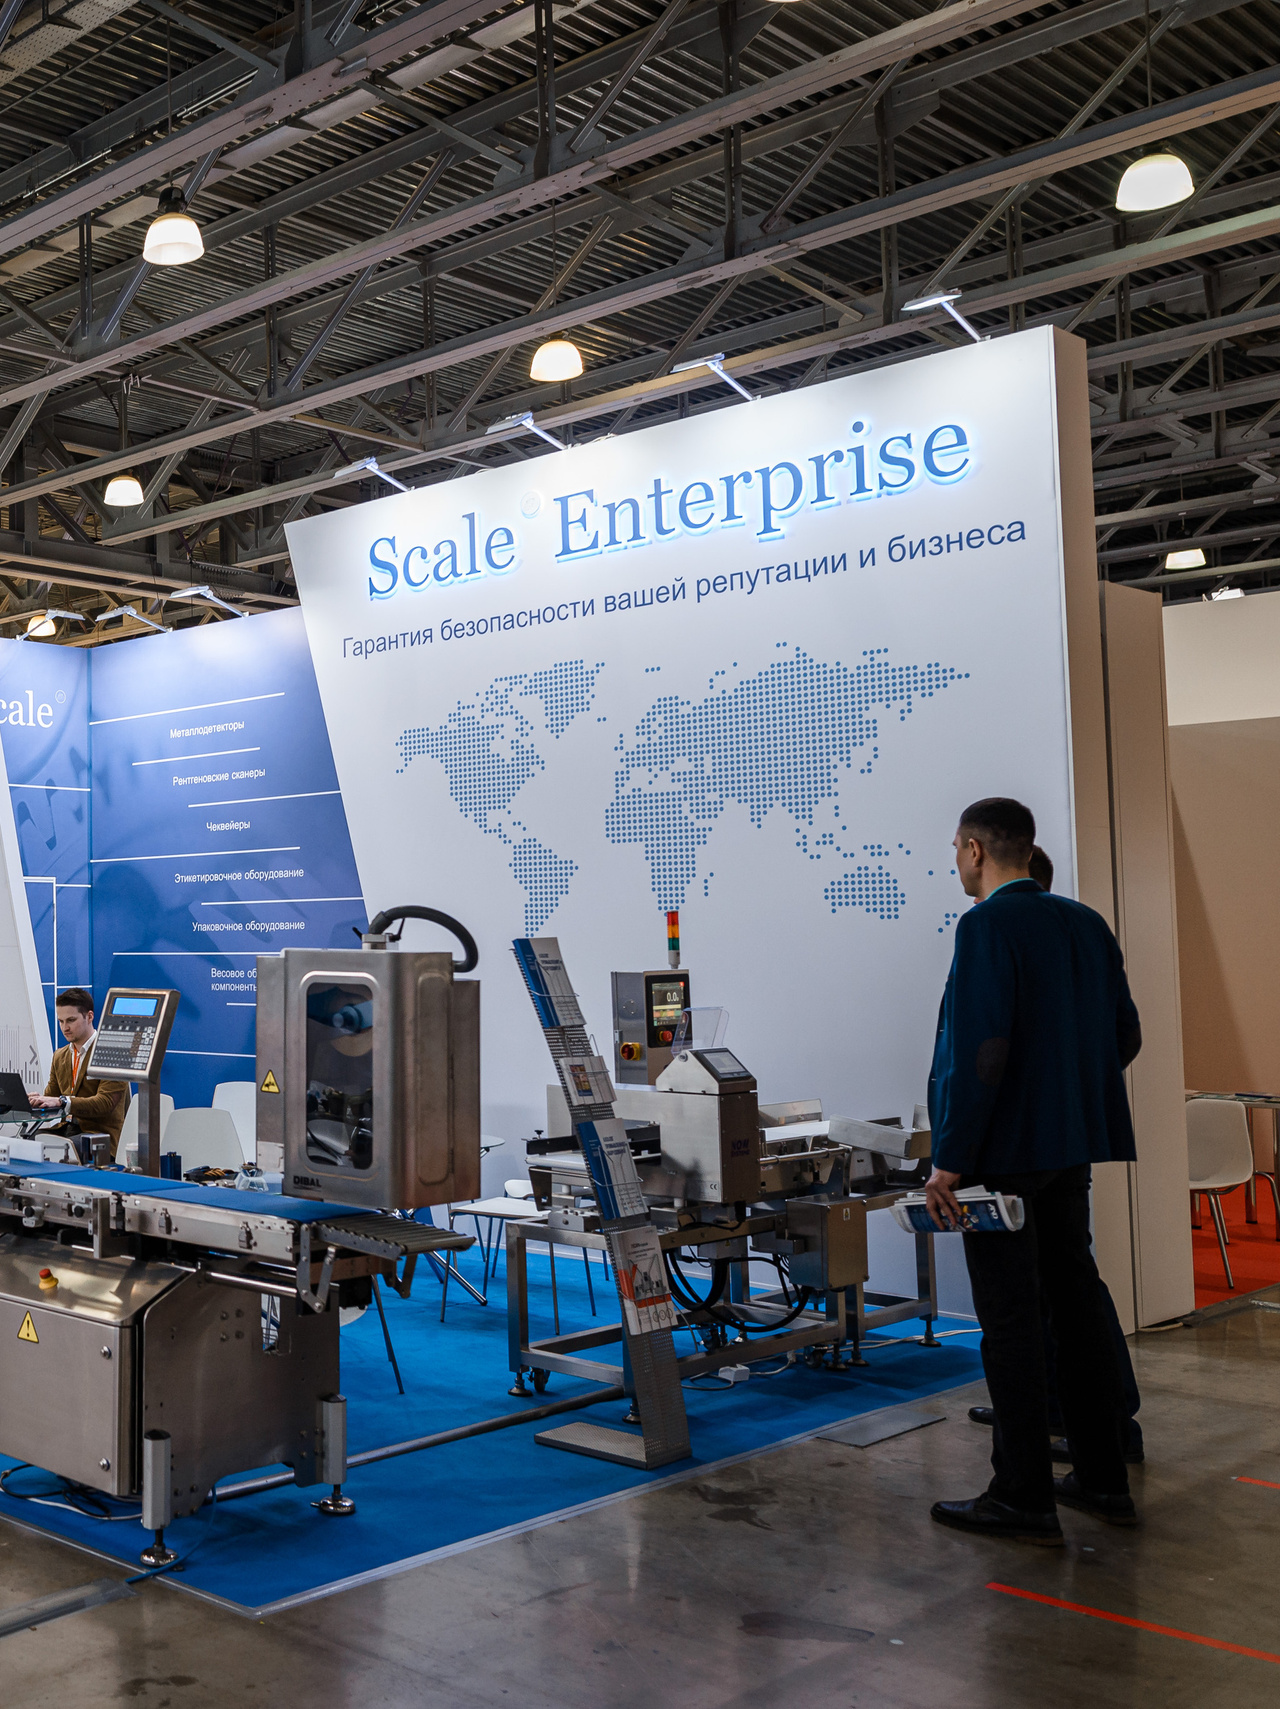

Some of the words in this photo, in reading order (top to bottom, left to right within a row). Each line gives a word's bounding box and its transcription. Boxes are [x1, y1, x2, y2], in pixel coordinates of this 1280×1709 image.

[368, 511, 517, 600] Scale
[552, 419, 972, 562] Enterprise
[342, 622, 434, 660] Гарантия
[439, 598, 597, 641] безопасности
[604, 575, 688, 614] вашей
[695, 549, 849, 604] репутации
[860, 543, 876, 568] и
[887, 518, 1027, 564] бизнеса
[169, 719, 245, 739] Металлодетекторы
[172, 769, 229, 787] Рентгеновские
[231, 766, 266, 782] сканеры
[206, 818, 251, 833] Чеквейеры
[174, 870, 242, 885] Этикетировочное
[244, 867, 304, 883] оборудование
[192, 920, 243, 933] Упаковочное
[245, 920, 306, 933] оборудование
[211, 968, 245, 978] Весовое
[293, 1175, 322, 1188] DIBAL
